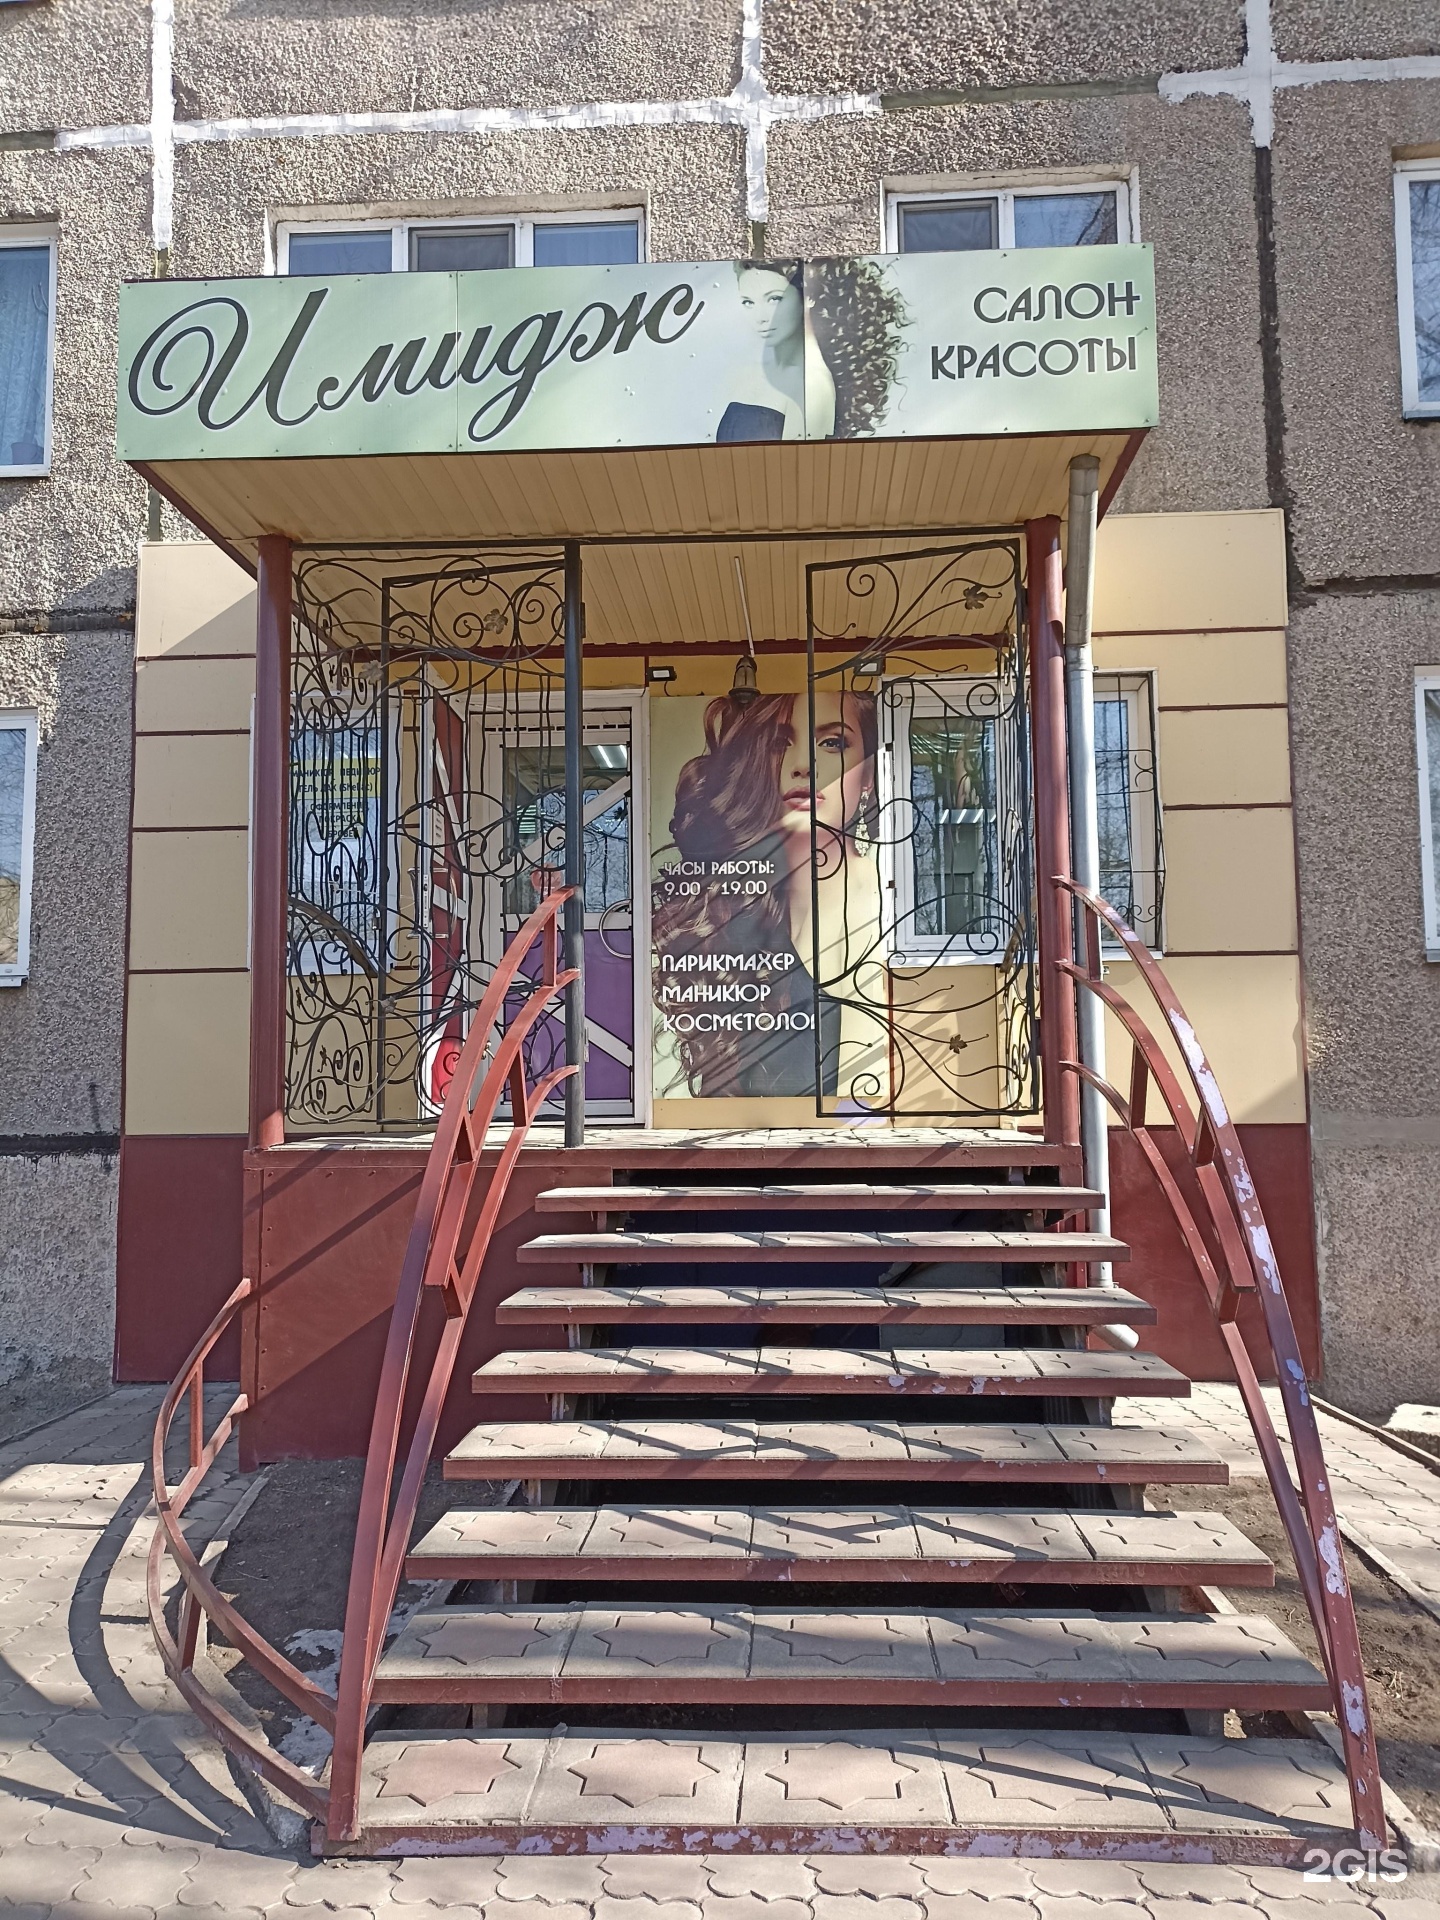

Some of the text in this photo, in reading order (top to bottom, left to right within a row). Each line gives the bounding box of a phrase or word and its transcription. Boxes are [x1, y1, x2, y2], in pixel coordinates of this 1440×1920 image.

[974, 281, 1141, 323] САЛОН
[128, 283, 705, 442] Имидж
[931, 336, 1136, 380] КРАСОТЫ
[340, 767, 381, 777] ПЕДИЮР
[328, 829, 357, 838] БРОВЕ
[664, 860, 775, 876] ЧАСЫ РАБОТЫ:
[664, 882, 701, 896] 9.00
[721, 880, 767, 895] 19.00
[662, 953, 795, 972] ПАРИКМАХЕР
[662, 984, 771, 1002] МАНИКЮР
